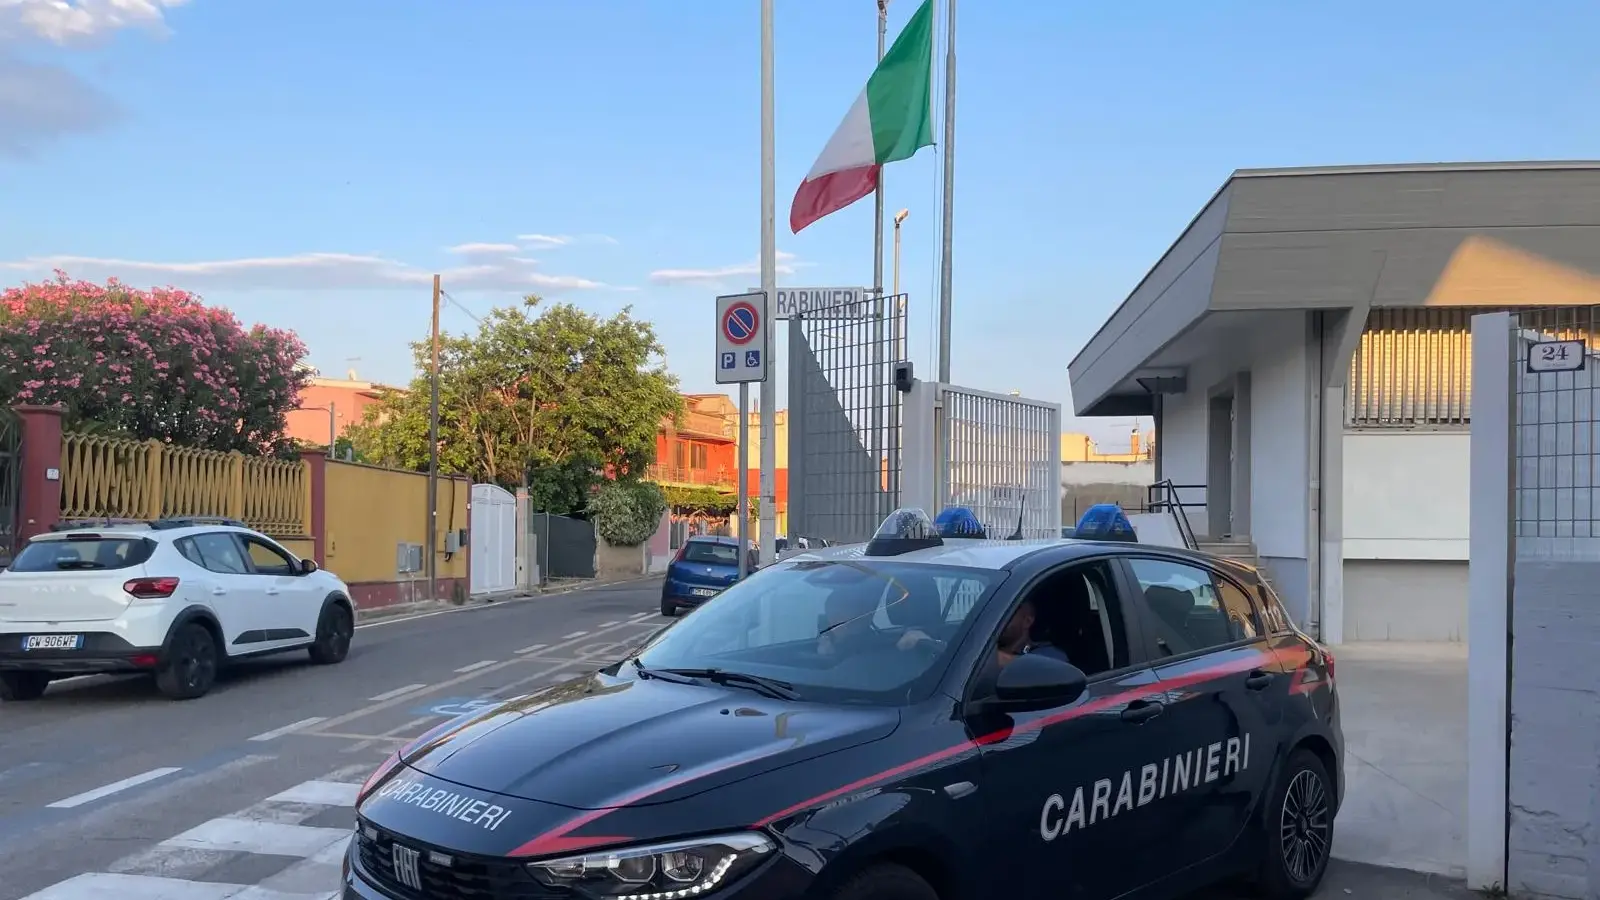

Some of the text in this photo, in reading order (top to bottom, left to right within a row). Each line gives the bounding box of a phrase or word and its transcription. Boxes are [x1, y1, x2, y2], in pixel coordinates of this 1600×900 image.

[777, 291, 858, 315] RABINIERI
[724, 354, 733, 368] P
[1542, 345, 1570, 360] 24
[379, 779, 512, 831] CARABINIERI
[1040, 733, 1250, 841] CARABINIERI
[392, 843, 422, 891] FIAT
